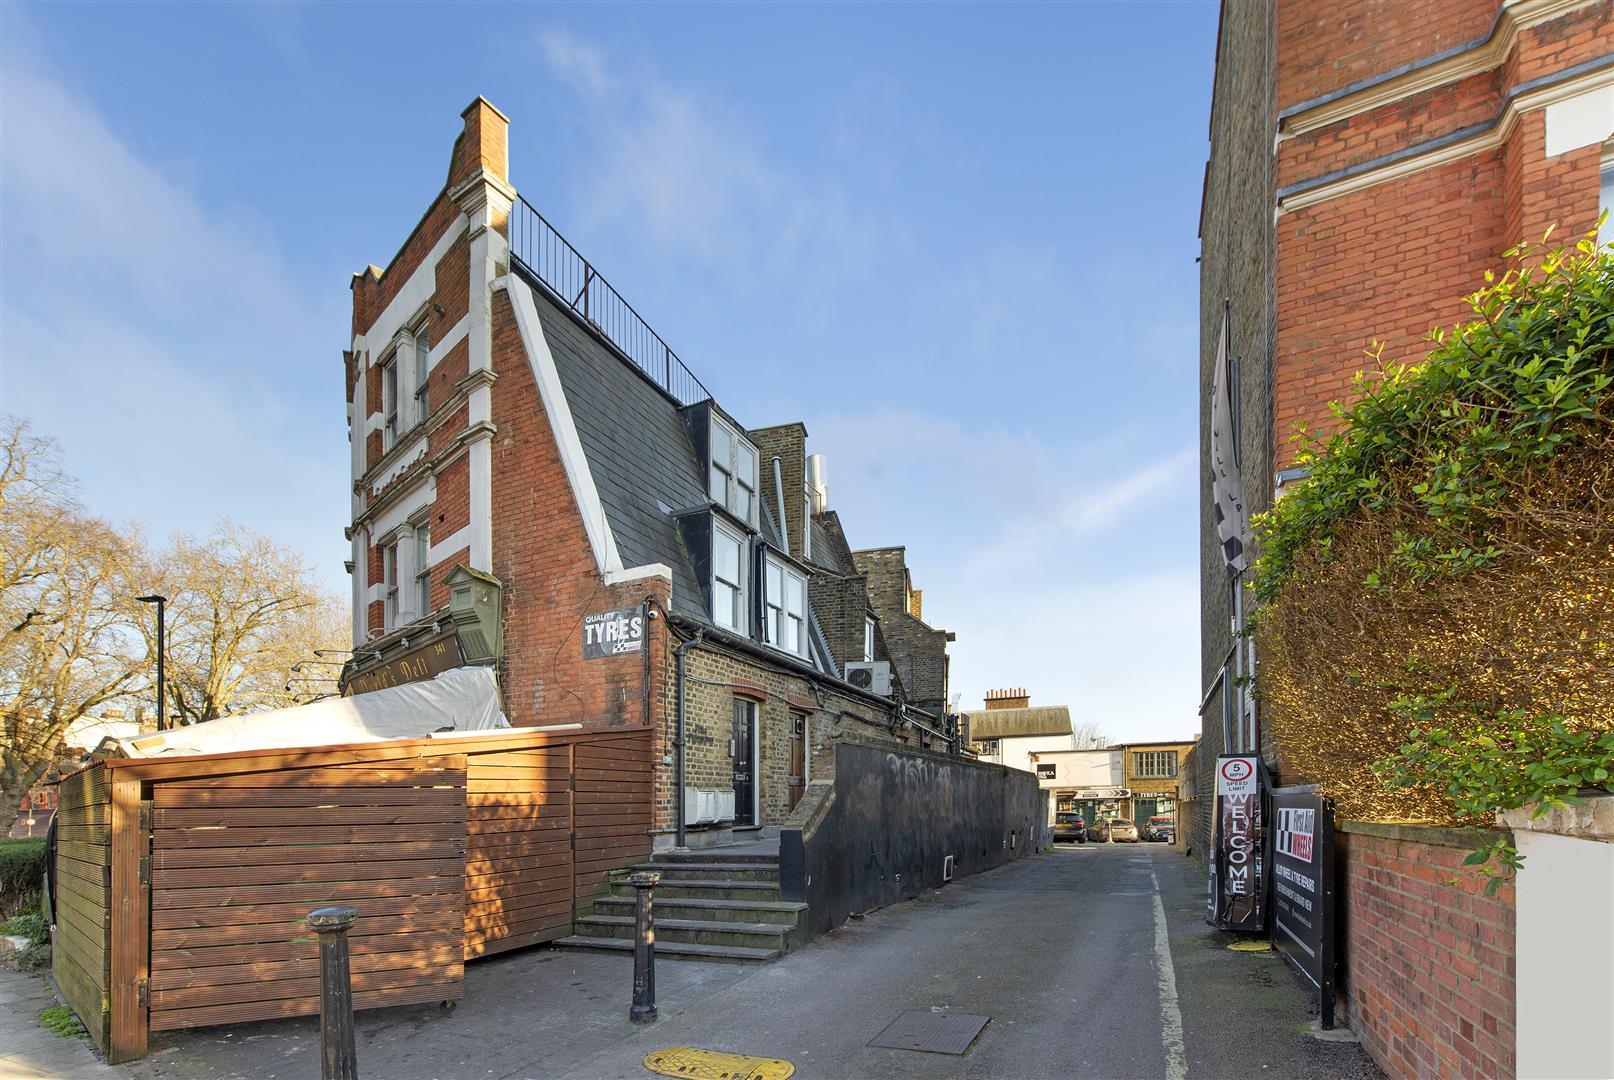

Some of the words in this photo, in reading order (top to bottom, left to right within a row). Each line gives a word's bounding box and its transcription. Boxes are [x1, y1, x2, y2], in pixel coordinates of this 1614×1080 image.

[585, 612, 614, 623] QUALITY
[584, 617, 642, 645] TYRES
[400, 658, 428, 680] Deli
[1233, 763, 1241, 772] 5
[1227, 794, 1249, 894] WELCOME
[1292, 833, 1312, 861] WHEELS
